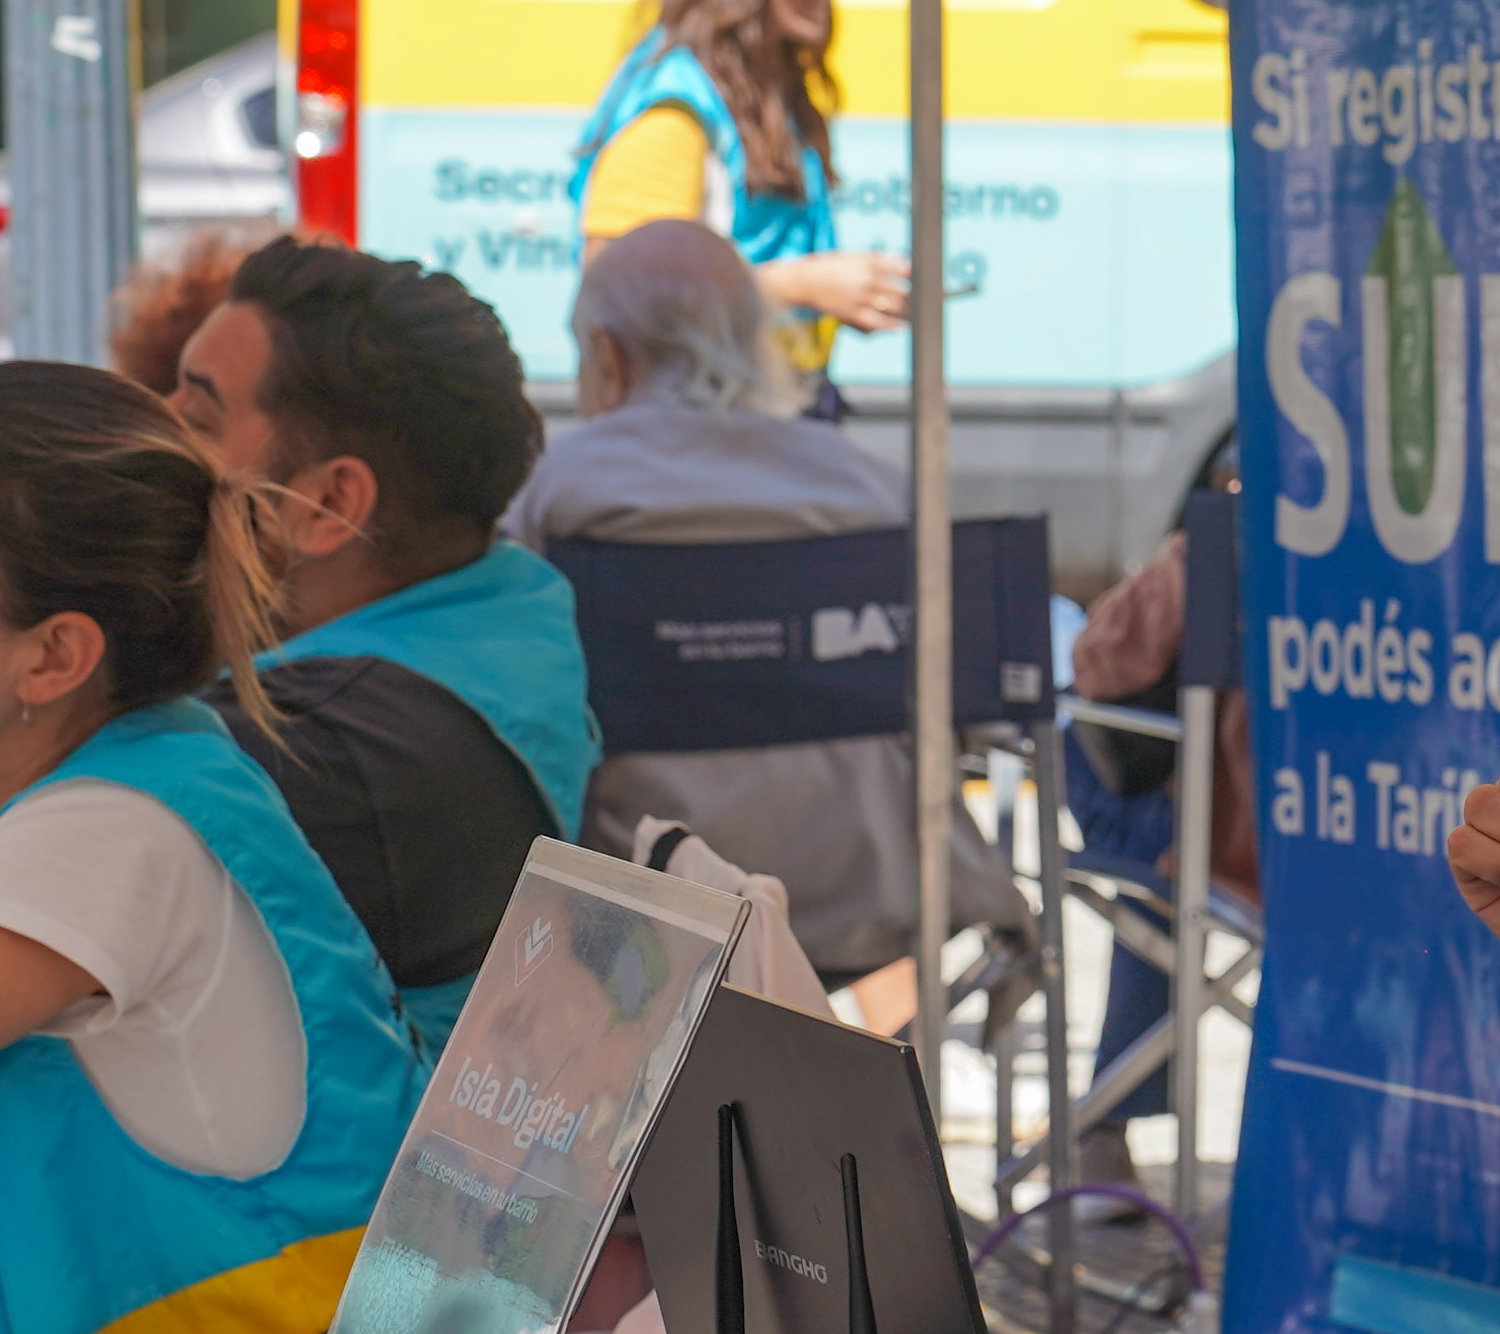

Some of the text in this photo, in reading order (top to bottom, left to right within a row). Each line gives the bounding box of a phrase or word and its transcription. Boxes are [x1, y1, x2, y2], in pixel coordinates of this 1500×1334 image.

[1252, 51, 1311, 152] Si
[1270, 599, 1435, 714] podés
[1273, 765, 1307, 838] a
[1315, 752, 1359, 846] la
[448, 1056, 590, 1154] Isla Digital
[436, 1162, 482, 1199] servicios
[480, 1183, 498, 1205] en
[506, 1195, 539, 1226] barrio
